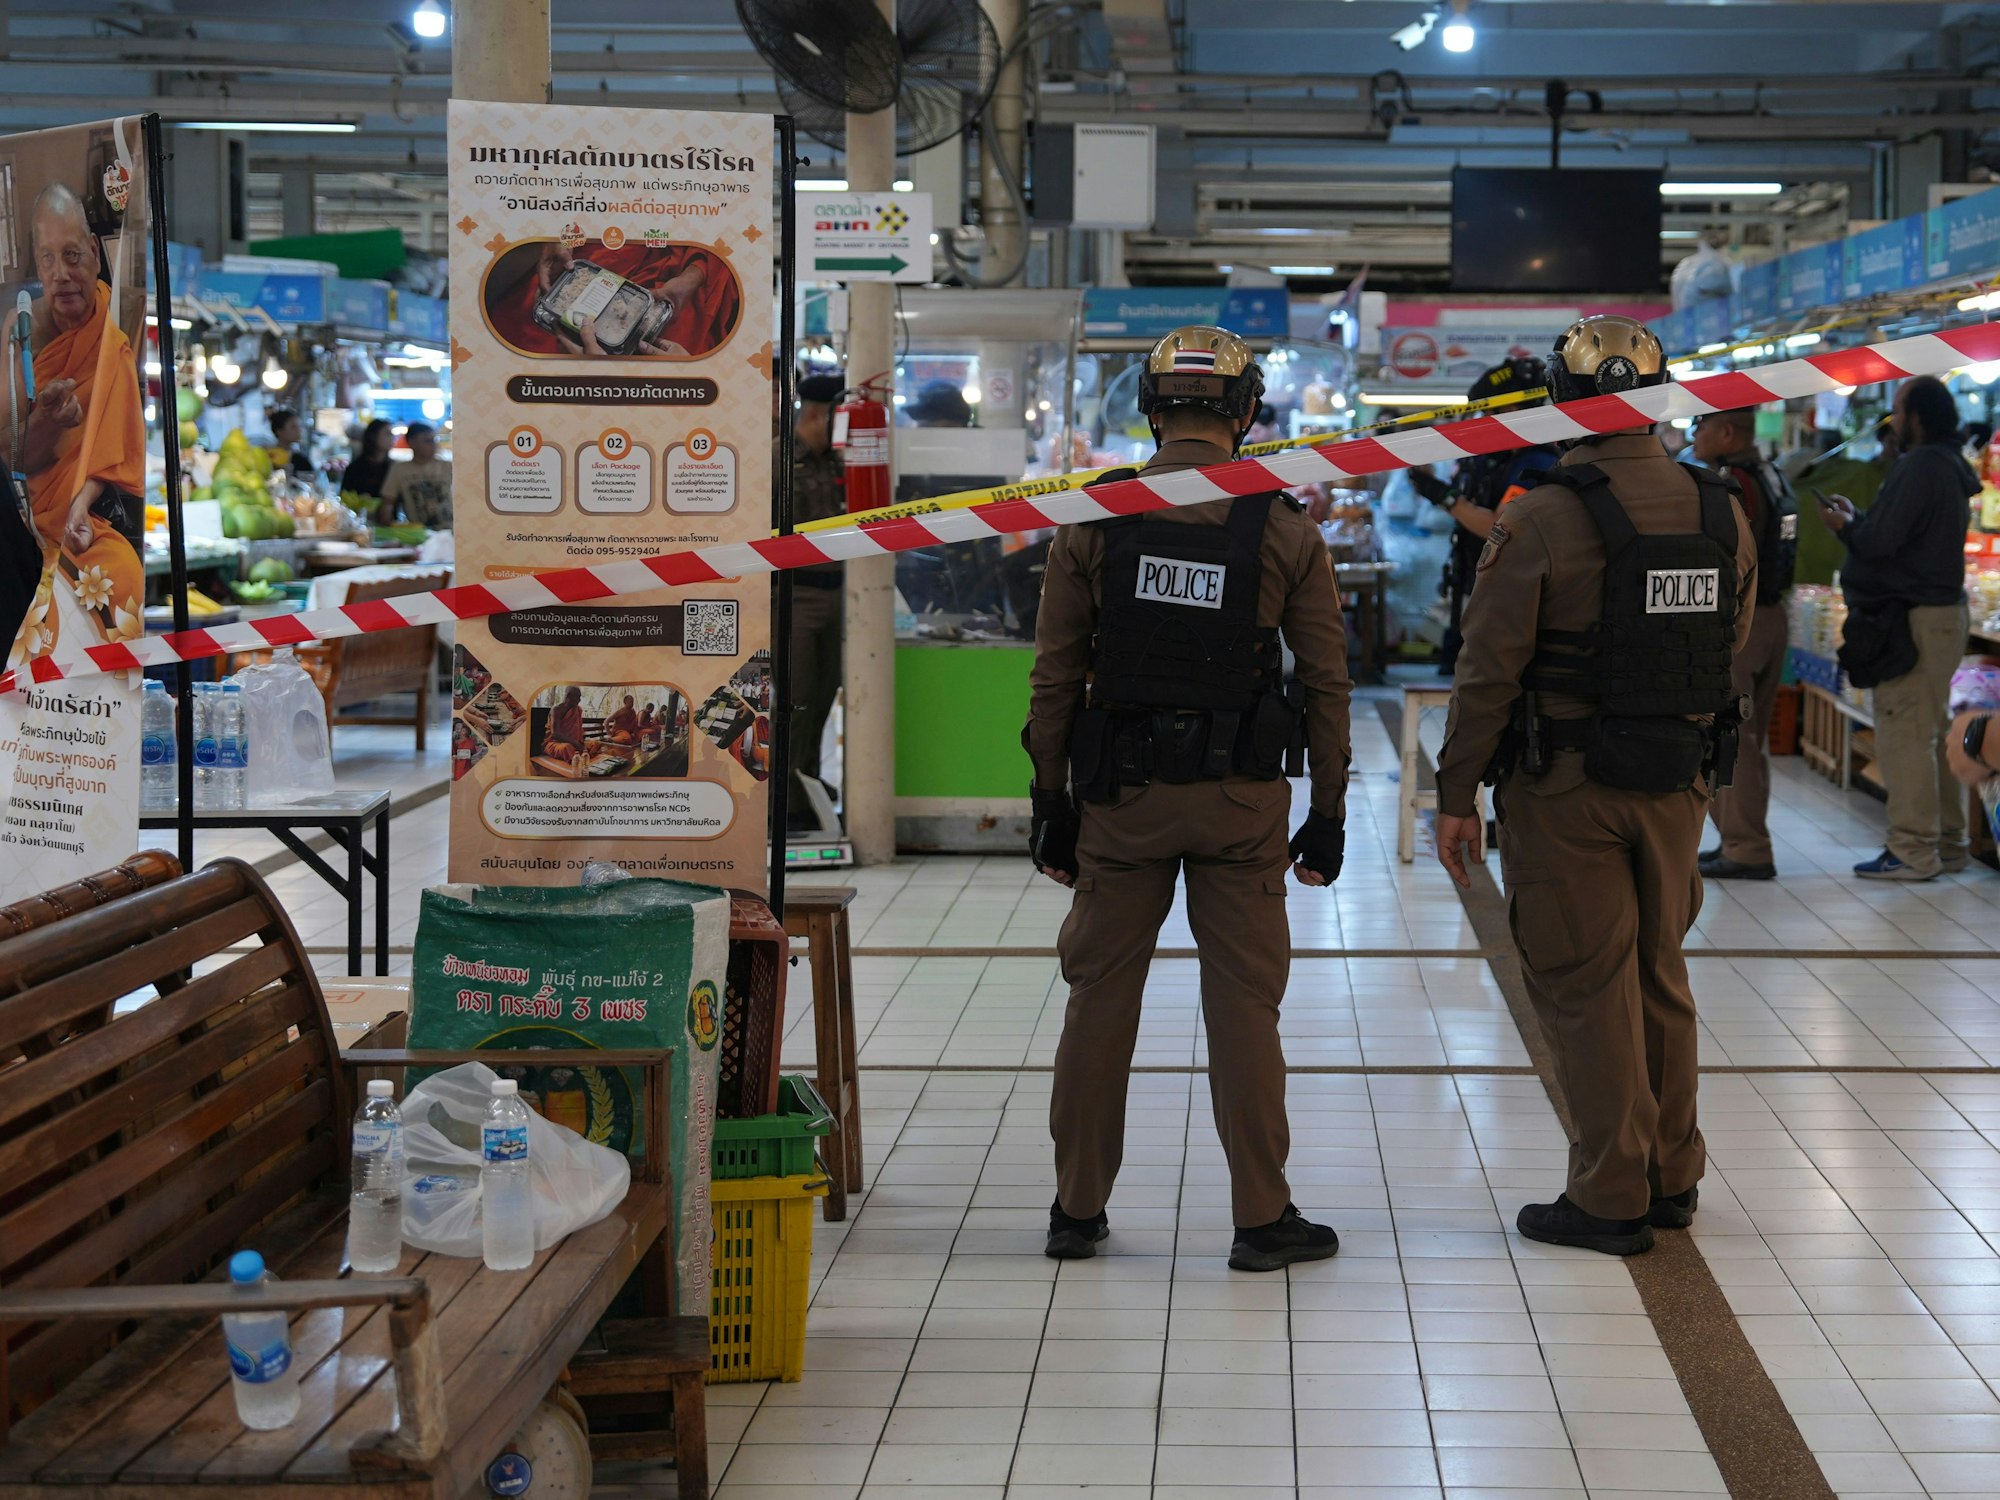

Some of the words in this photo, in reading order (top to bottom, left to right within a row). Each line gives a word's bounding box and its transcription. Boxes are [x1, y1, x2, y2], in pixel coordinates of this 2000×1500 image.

[469, 144, 755, 172] มหากุศลตักบาตรไร้โรค
[474, 172, 636, 190] ถวายภัตตาหารเพื่อสุขภาพ
[643, 179, 751, 196] แด่พระภิกษุอาพาธ
[644, 231, 669, 239] HEALTH
[521, 378, 705, 399] ขั้นตอนการถวายภัตตาหาร
[517, 436, 531, 447] 01
[607, 438, 623, 449] 02
[693, 440, 707, 450] 03
[506, 532, 606, 546] รับจัดทำอาหารเพื่อสุขภาพ
[566, 545, 594, 556] ติดต่อ
[596, 546, 660, 556] 095-9529404
[1141, 562, 1219, 603] POLICE
[1651, 574, 1714, 607] POLICE
[646, 624, 663, 636] ได้ที่
[669, 804, 691, 813] NCDs
[480, 855, 561, 872] สนับสนุนโดย
[442, 953, 530, 986] ข้าวเหนียวหอม
[541, 968, 576, 991] พันธุ์
[581, 969, 649, 988] กข-แม่โจ้
[653, 973, 663, 987] 2
[456, 988, 492, 1014] ตรา
[499, 985, 562, 1019] กระติ๊บ
[572, 997, 591, 1021] 3
[601, 999, 648, 1022] เพชร
